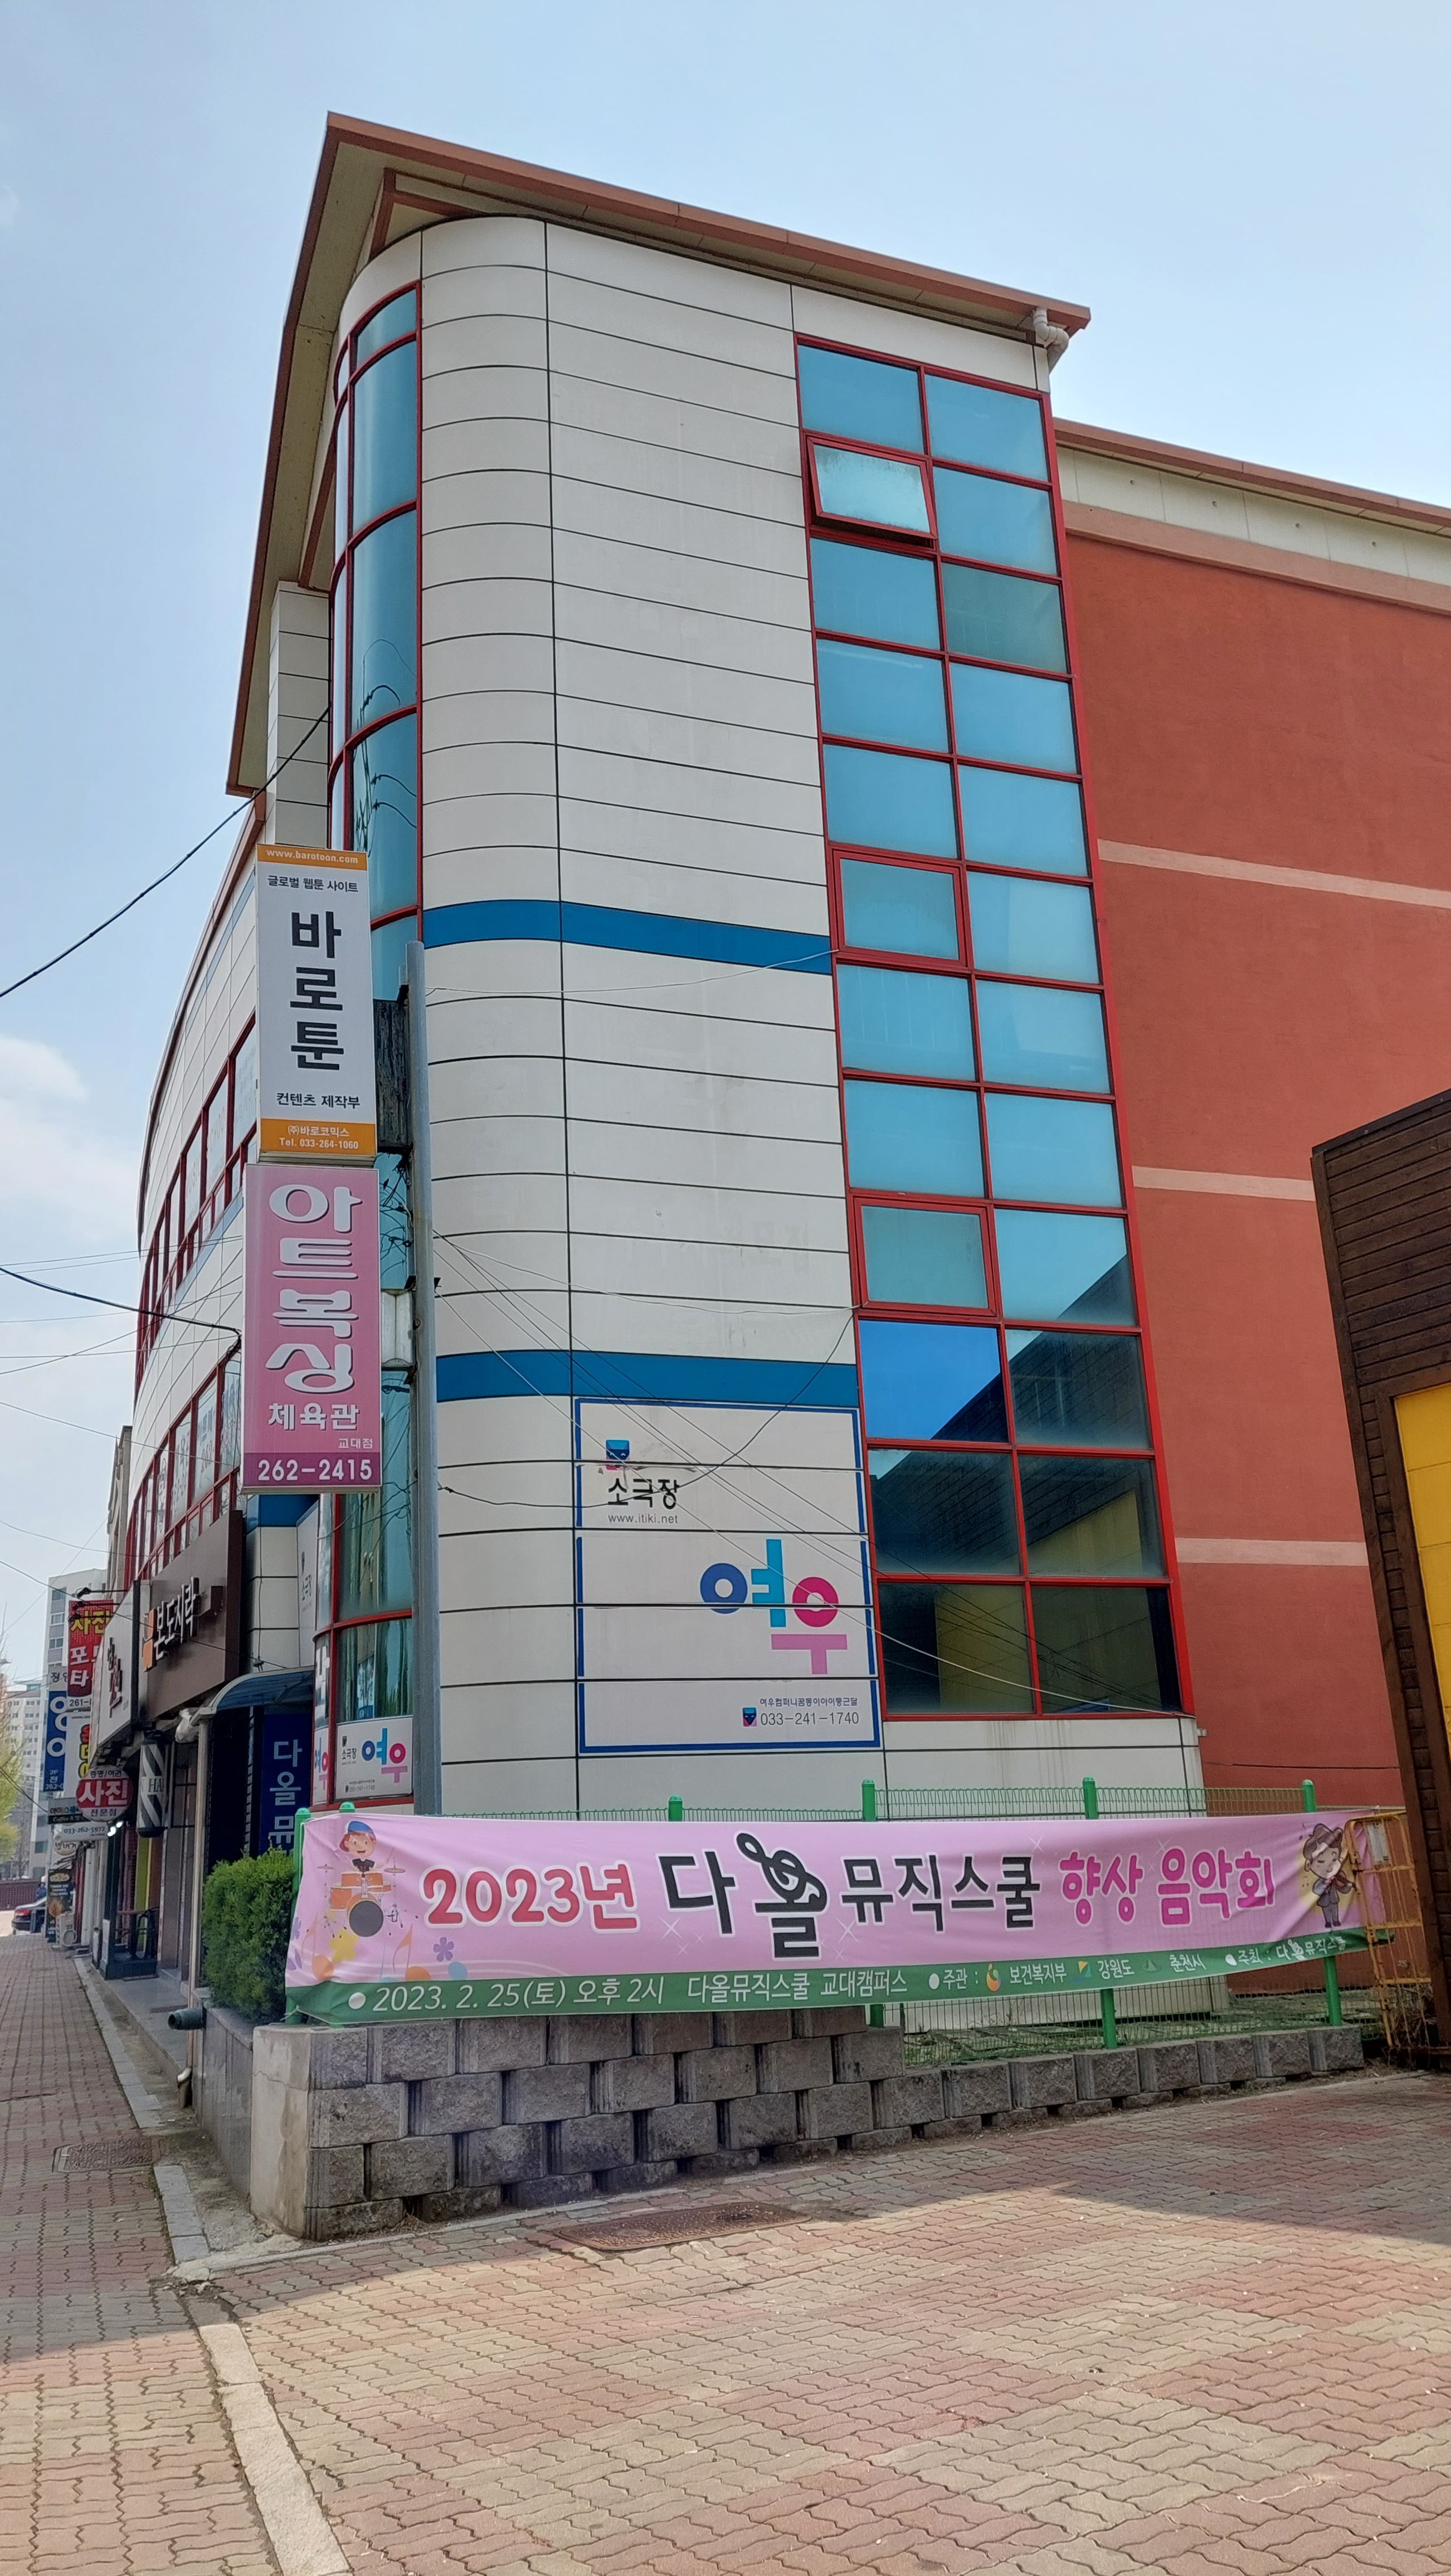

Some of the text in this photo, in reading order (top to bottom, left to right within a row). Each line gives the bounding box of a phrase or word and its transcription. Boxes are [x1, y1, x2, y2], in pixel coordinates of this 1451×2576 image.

[266, 850, 358, 863] www.barotoon.com
[267, 875, 358, 892] 글로벌 웹툰 사이트
[290, 911, 344, 1071] 바로툰
[276, 1092, 361, 1109] 컨텐츠 제작부
[279, 1138, 359, 1149] Tel. 033-264-1060
[265, 1183, 363, 1394] 아트복싱
[267, 1403, 360, 1431] 체육관
[338, 1437, 373, 1450] 교대점
[257, 1458, 372, 1482] 262-2415
[607, 1477, 680, 1509] 소극장
[607, 1512, 679, 1524] www.itiki.net
[154, 1576, 199, 1661] 본도시락
[699, 1539, 848, 1675] 여우
[761, 1711, 859, 1725] 033-241-1740
[361, 1728, 408, 1783] 여우
[78, 1779, 128, 1807] 사진
[421, 1862, 639, 1931] 2023년
[1059, 1851, 1143, 1924] 향상
[1157, 1848, 1275, 1926] 음악회
[1238, 1948, 1264, 1966] 주최
[943, 1968, 968, 1990] 주관
[1010, 1962, 1067, 1985] 보건복지부
[1097, 1959, 1135, 1979] 강원도
[1169, 1954, 1206, 1973] 춘천시
[372, 1987, 446, 2012] 2023.
[487, 1979, 566, 2008] 25(토)
[573, 1978, 621, 2006] 오후
[626, 1976, 665, 2004] 2시
[687, 1973, 811, 2003] 다올뮤직스쿨
[820, 1970, 908, 1997] 교대캠퍼스
